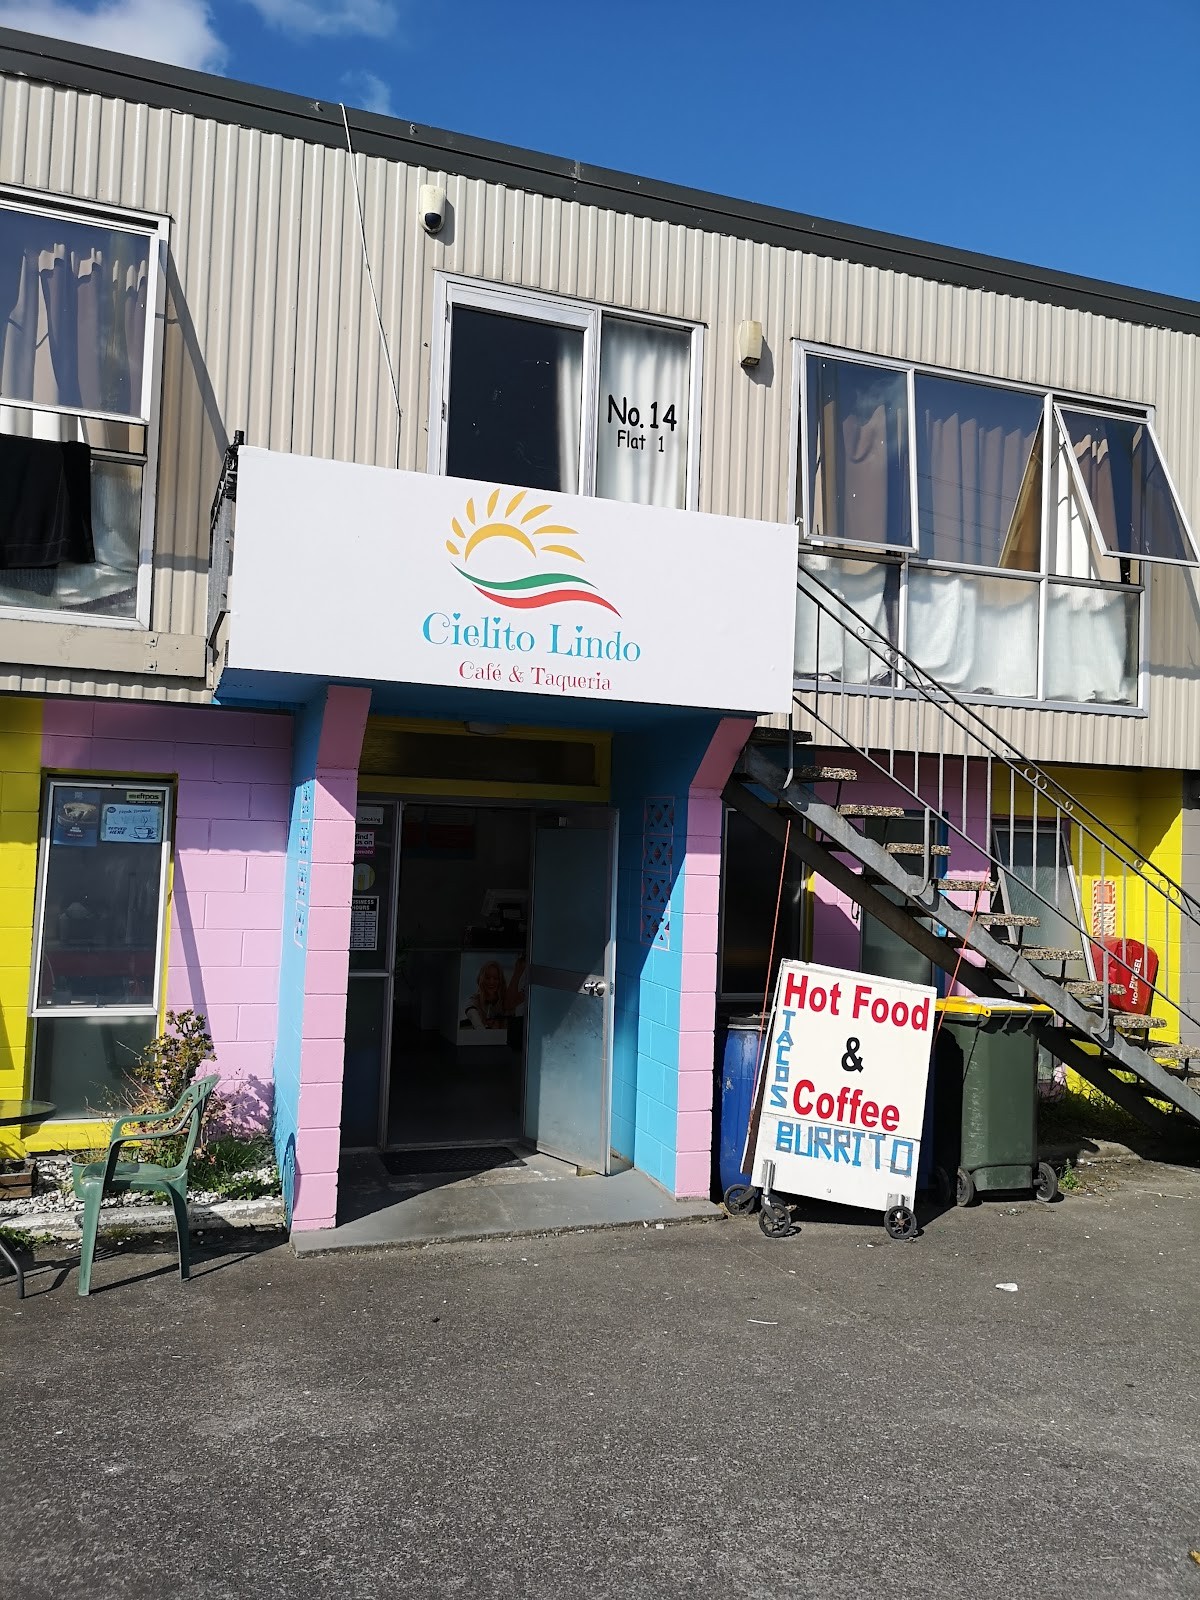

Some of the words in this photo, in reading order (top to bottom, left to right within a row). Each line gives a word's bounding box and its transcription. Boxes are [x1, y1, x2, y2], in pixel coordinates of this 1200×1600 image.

[617, 429, 646, 450] Flat
[658, 435, 665, 452] 1
[422, 611, 536, 652] Cielito
[546, 624, 641, 662] Lindo
[458, 660, 502, 682] Café
[508, 665, 524, 683] &
[530, 666, 612, 692] Taqueria
[783, 972, 842, 1016] Hot
[852, 984, 931, 1032] Food
[770, 1009, 796, 1109] TACOS
[841, 1036, 864, 1073] &
[793, 1079, 900, 1132] Coffee
[775, 1120, 914, 1177] BURRITO
